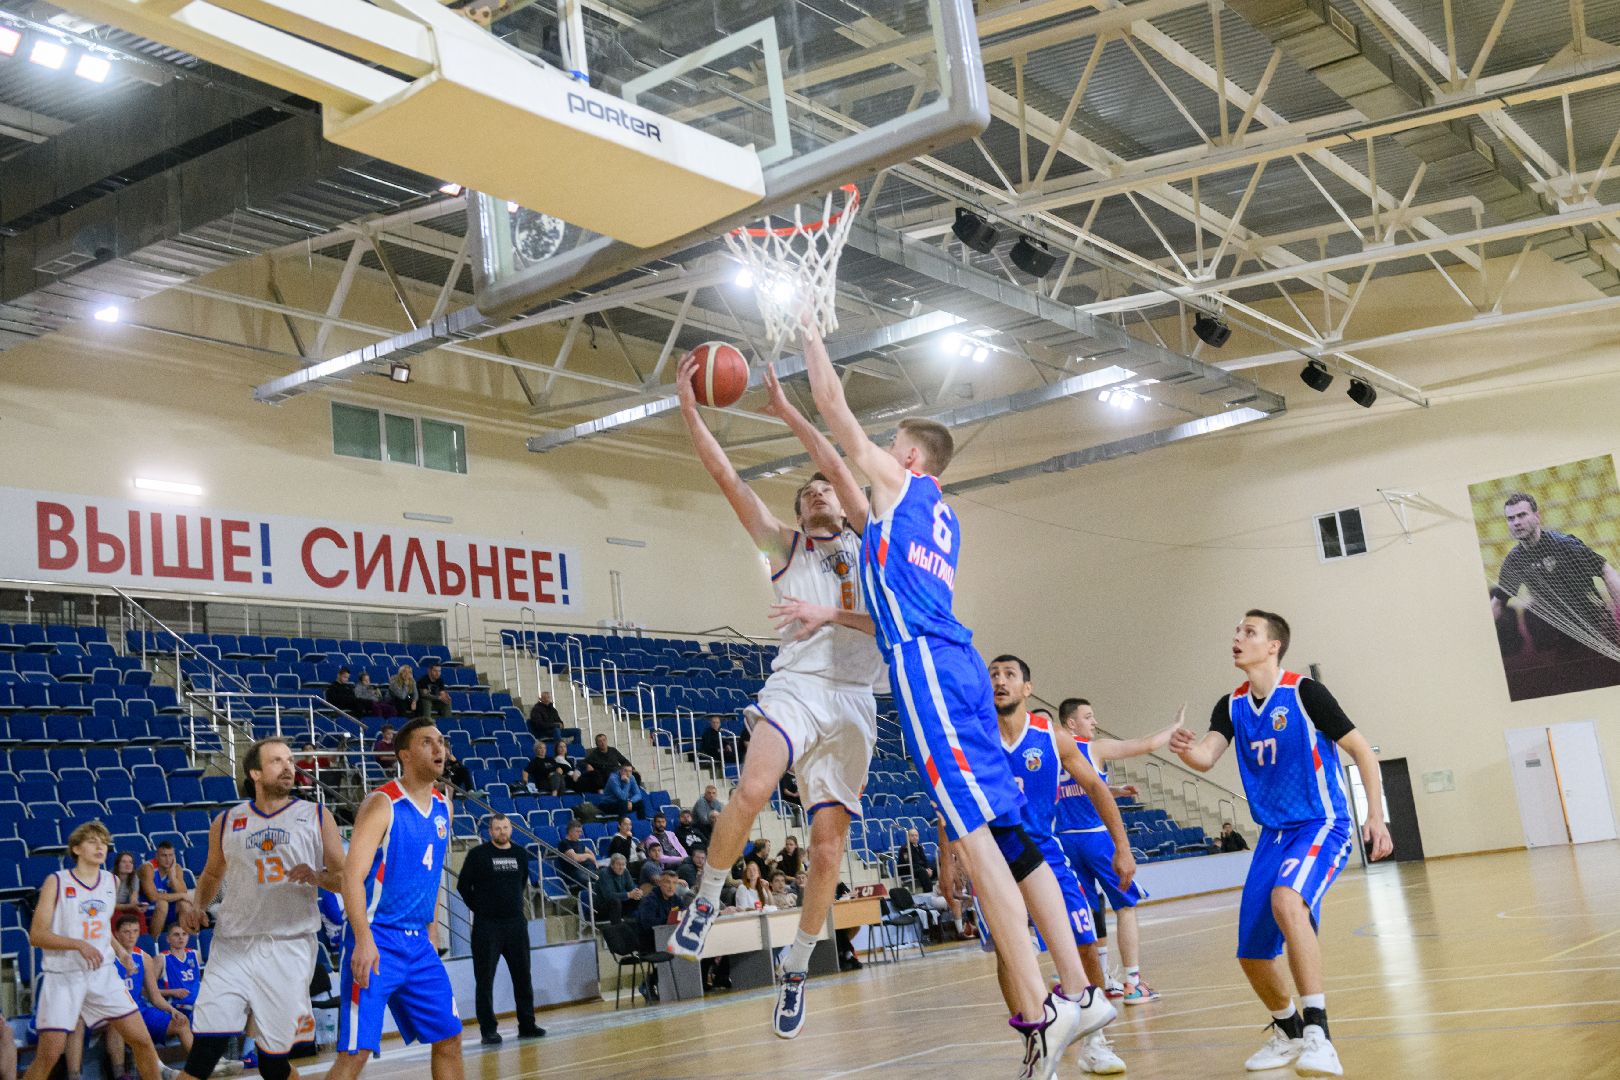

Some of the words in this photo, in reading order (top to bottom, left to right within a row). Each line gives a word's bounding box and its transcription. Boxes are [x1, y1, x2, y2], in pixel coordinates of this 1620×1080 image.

[932, 500, 952, 554] 6
[36, 500, 273, 584] ВЫШЕ!
[301, 526, 570, 605] СИЛЬНЕЕ!
[1250, 737, 1277, 766] 77
[255, 857, 285, 884] 13
[422, 843, 433, 871] 4
[82, 921, 104, 939] 12
[1071, 907, 1091, 934] 13
[180, 968, 194, 982] 35
